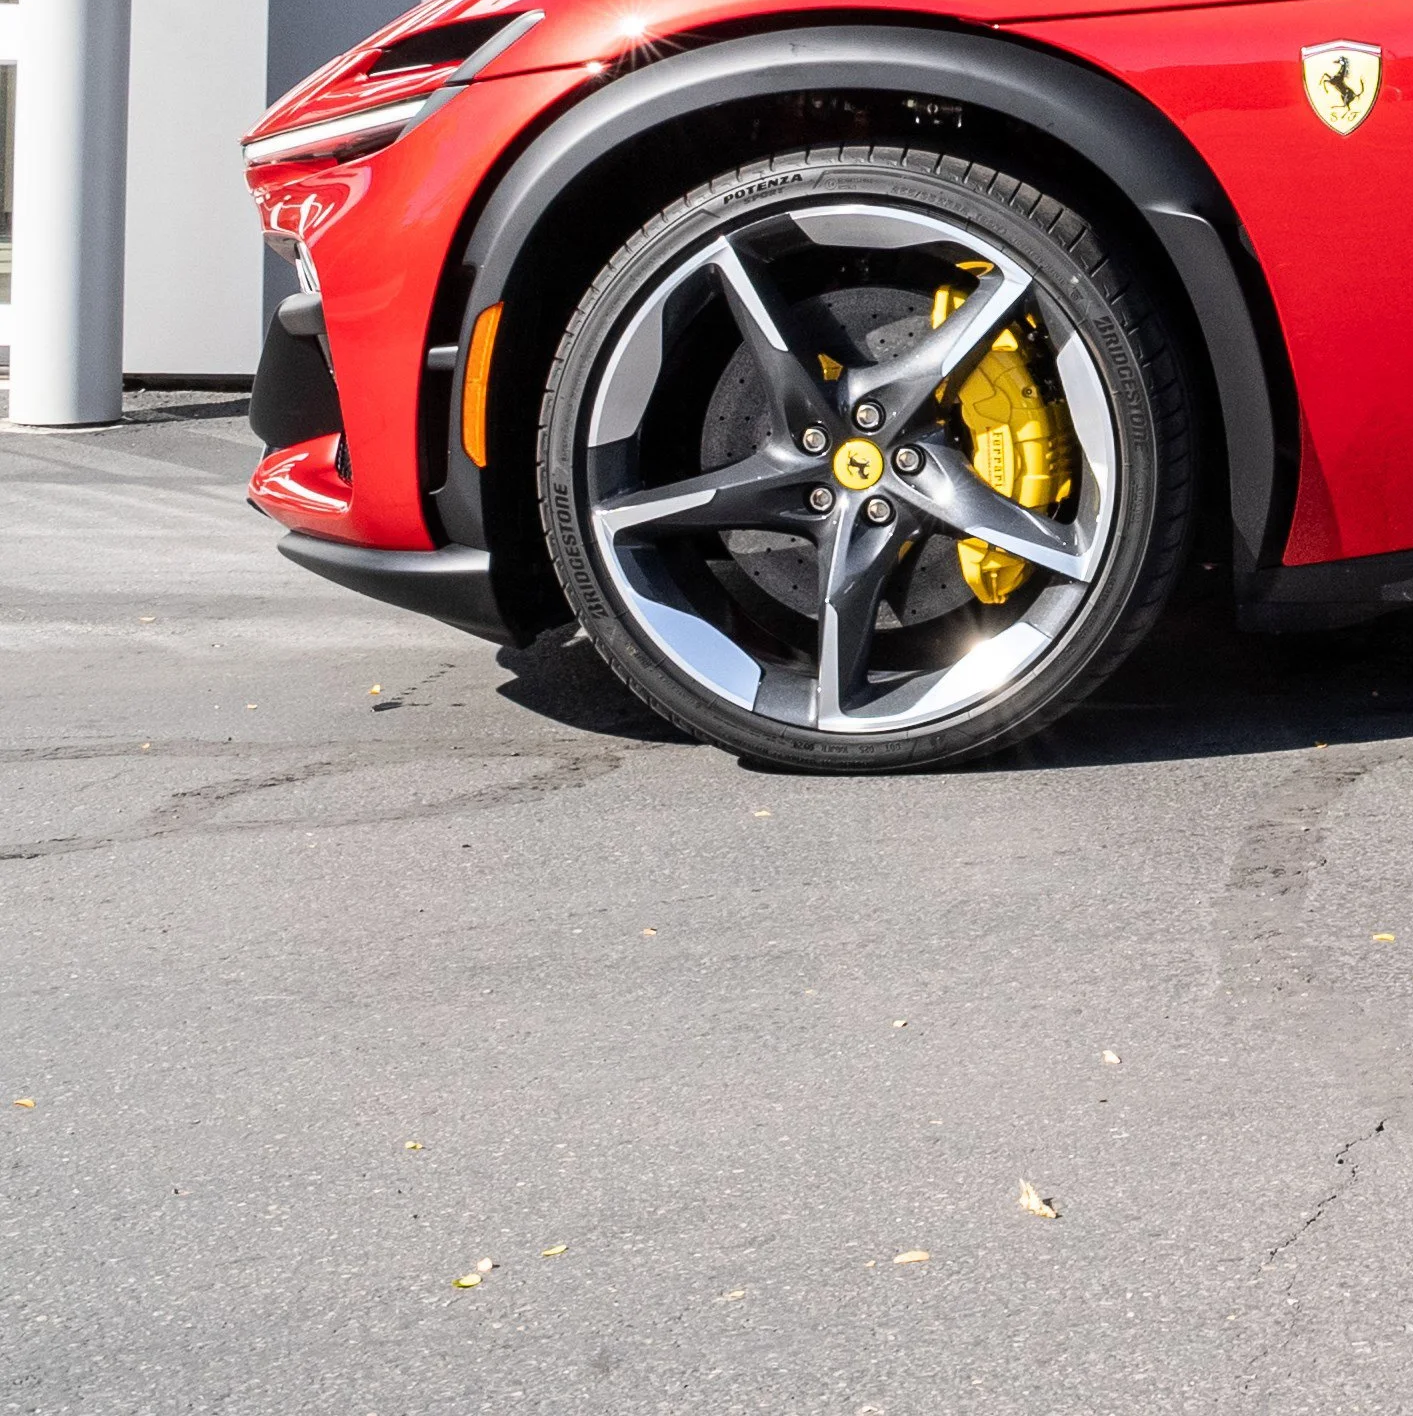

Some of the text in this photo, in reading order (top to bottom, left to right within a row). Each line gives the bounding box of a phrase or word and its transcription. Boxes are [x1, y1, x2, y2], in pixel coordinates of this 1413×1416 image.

[723, 173, 803, 205] POTENZA
[992, 431, 1005, 487] Ferrari
[552, 481, 610, 620] BRIDGESTONE
